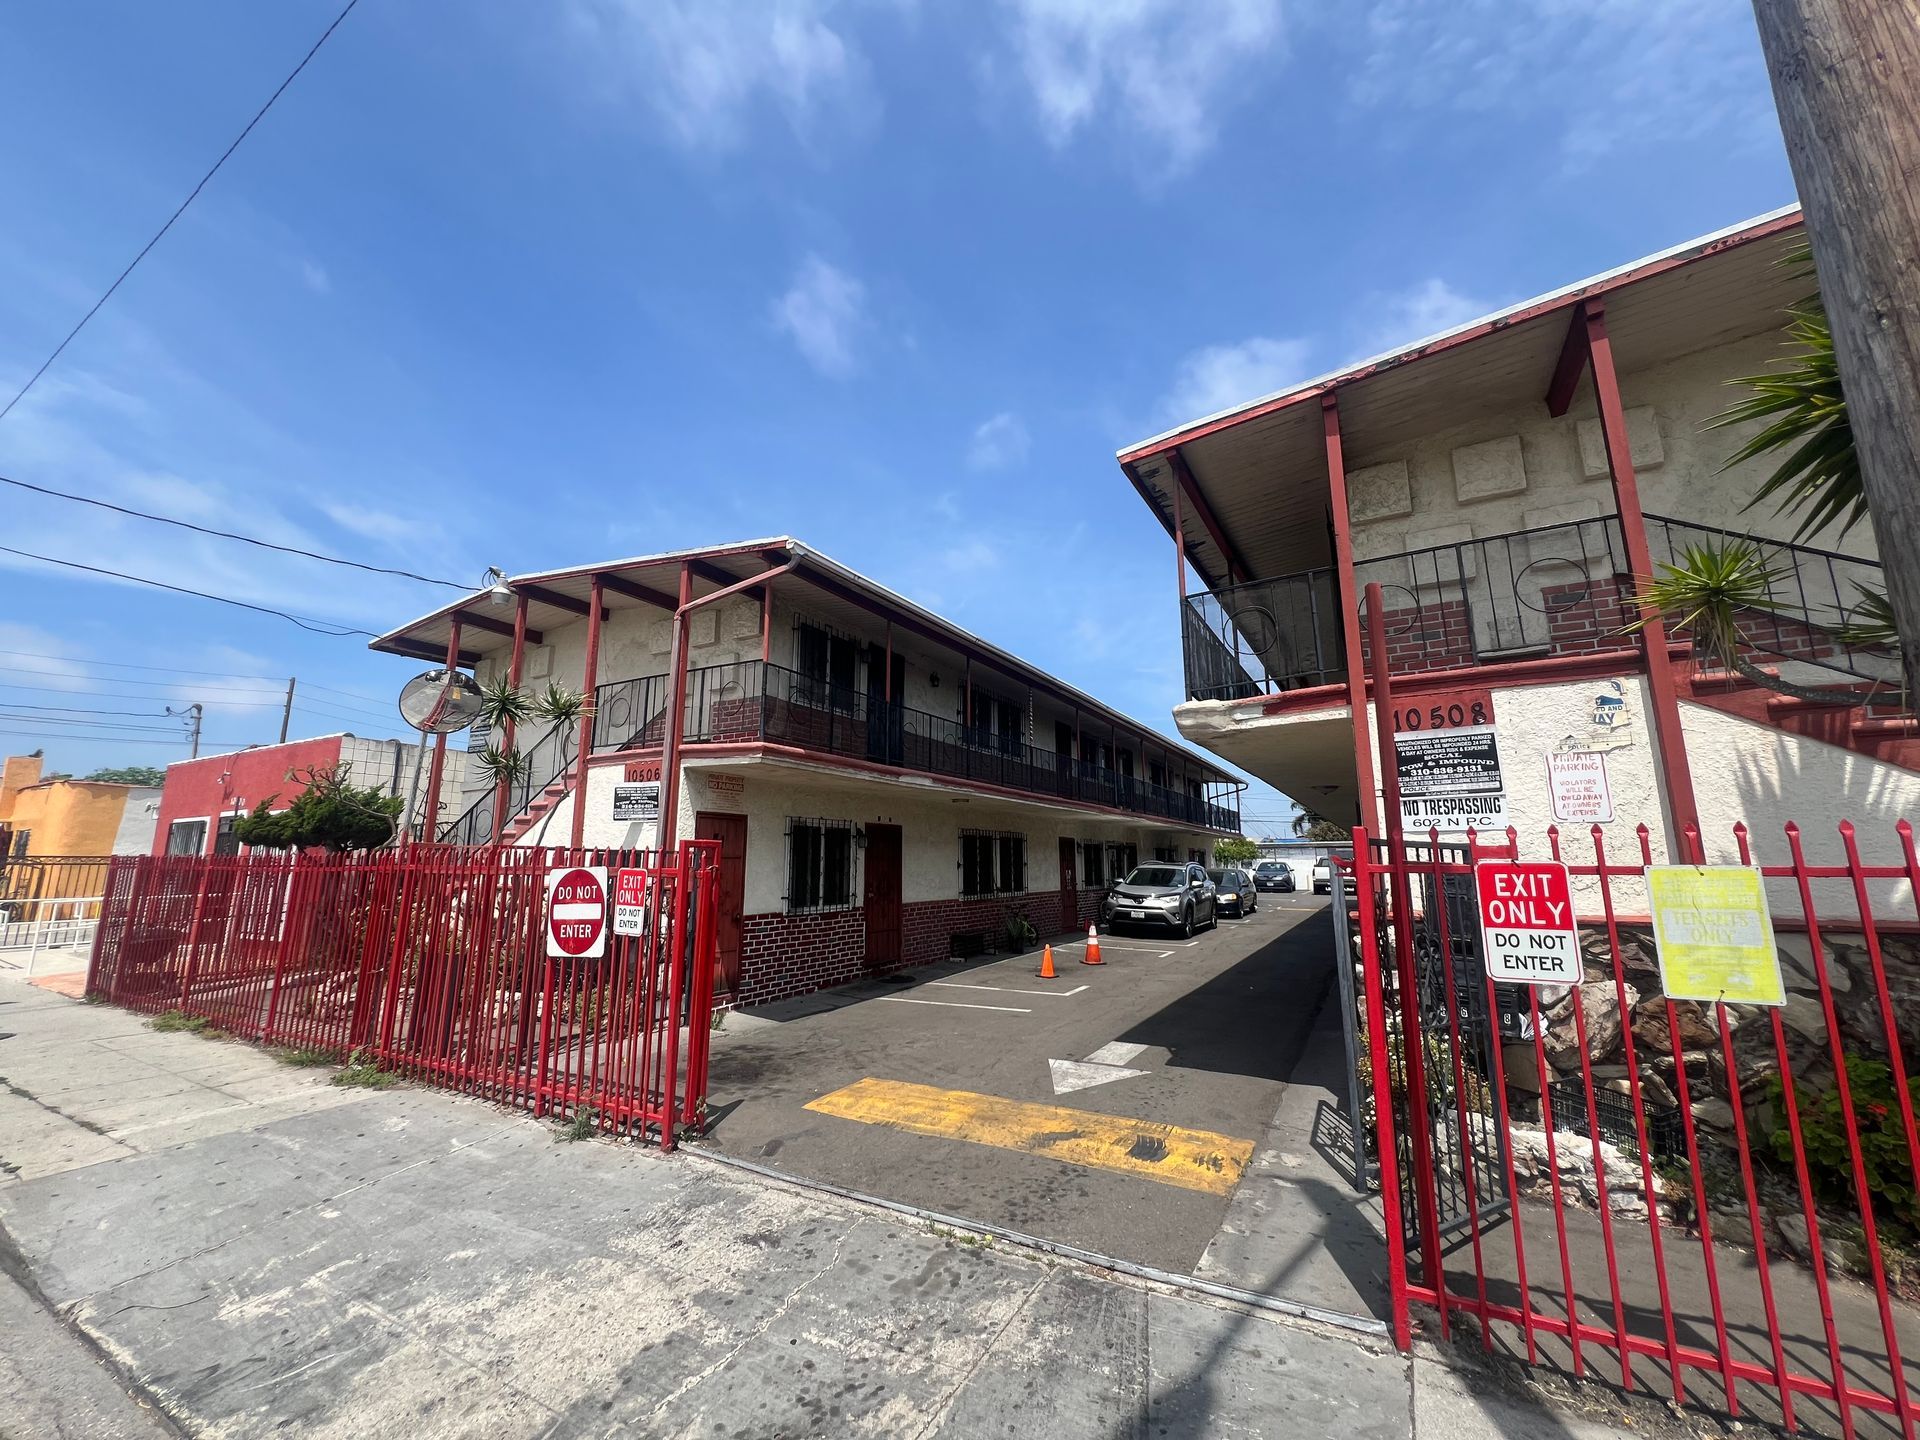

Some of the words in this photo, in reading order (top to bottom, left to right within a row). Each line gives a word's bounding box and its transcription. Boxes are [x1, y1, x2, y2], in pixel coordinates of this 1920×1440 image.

[1393, 701, 1487, 732] 10508
[1395, 739, 1432, 747] UNAUTHORIZED
[1424, 752, 1462, 760] SOCAL
[1399, 762, 1424, 772] TOW
[1439, 758, 1495, 766] IMPOUND
[1410, 765, 1483, 776] 310-636-9131
[1554, 762, 1599, 773] PARKING
[628, 768, 660, 782] 10506
[1402, 800, 1420, 816] NO
[1422, 797, 1501, 816] TRESPASSING
[1412, 818, 1442, 828] 602
[1448, 818, 1460, 826] N
[1466, 816, 1495, 826] P.C.
[623, 876, 642, 889] EXIT
[1494, 873, 1552, 897] EXIT
[558, 886, 572, 900] DO
[576, 886, 598, 900] NOT
[619, 890, 644, 904] ONLY
[618, 908, 626, 916] DO
[629, 909, 641, 918] NOT
[1488, 900, 1565, 925] ONLY
[1673, 911, 1749, 928] TENANTS
[560, 924, 592, 938] ENTER
[619, 920, 638, 929] ENTER
[1495, 933, 1520, 948] DO
[1529, 934, 1567, 950] NOT
[1691, 928, 1737, 944] ONLY
[1503, 954, 1565, 972] ENTER
